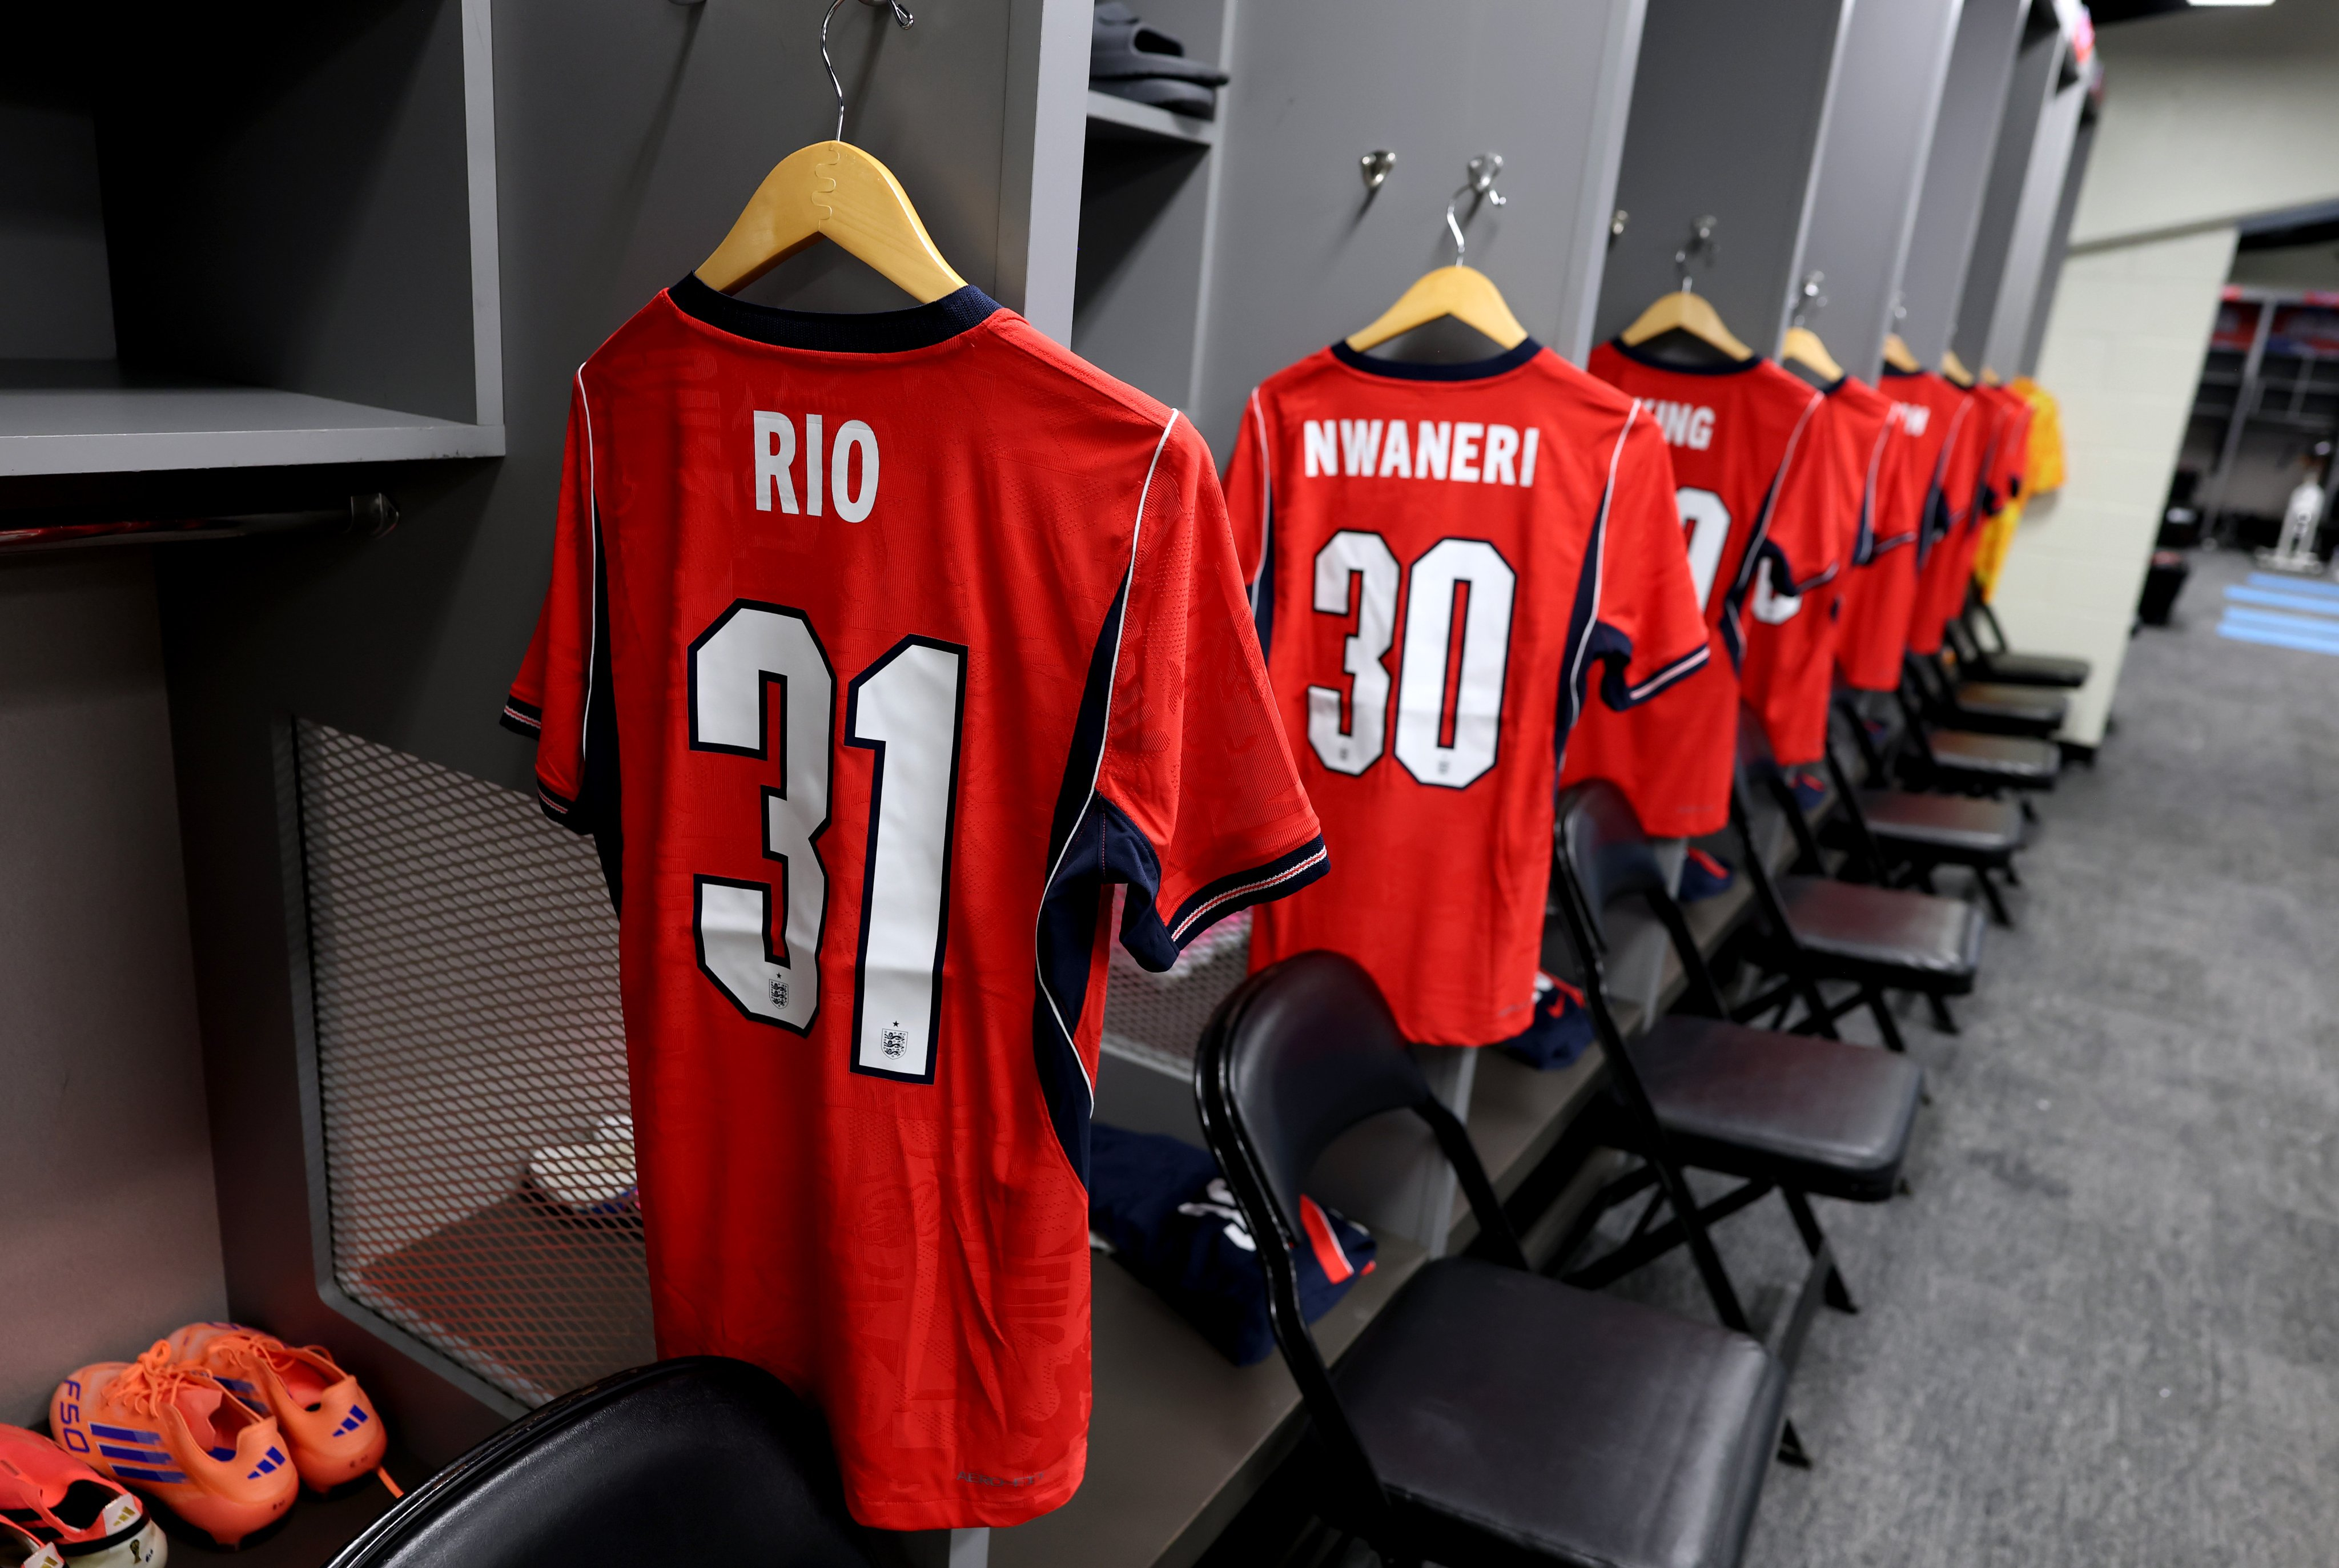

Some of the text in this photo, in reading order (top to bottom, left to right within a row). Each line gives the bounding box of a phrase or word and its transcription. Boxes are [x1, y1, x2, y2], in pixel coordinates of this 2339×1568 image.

[753, 410, 879, 523] RIO
[1303, 419, 1540, 488] NWANERI
[1308, 528, 1517, 790] 30
[687, 597, 969, 1086] 31
[60, 1379, 90, 1453] F50
